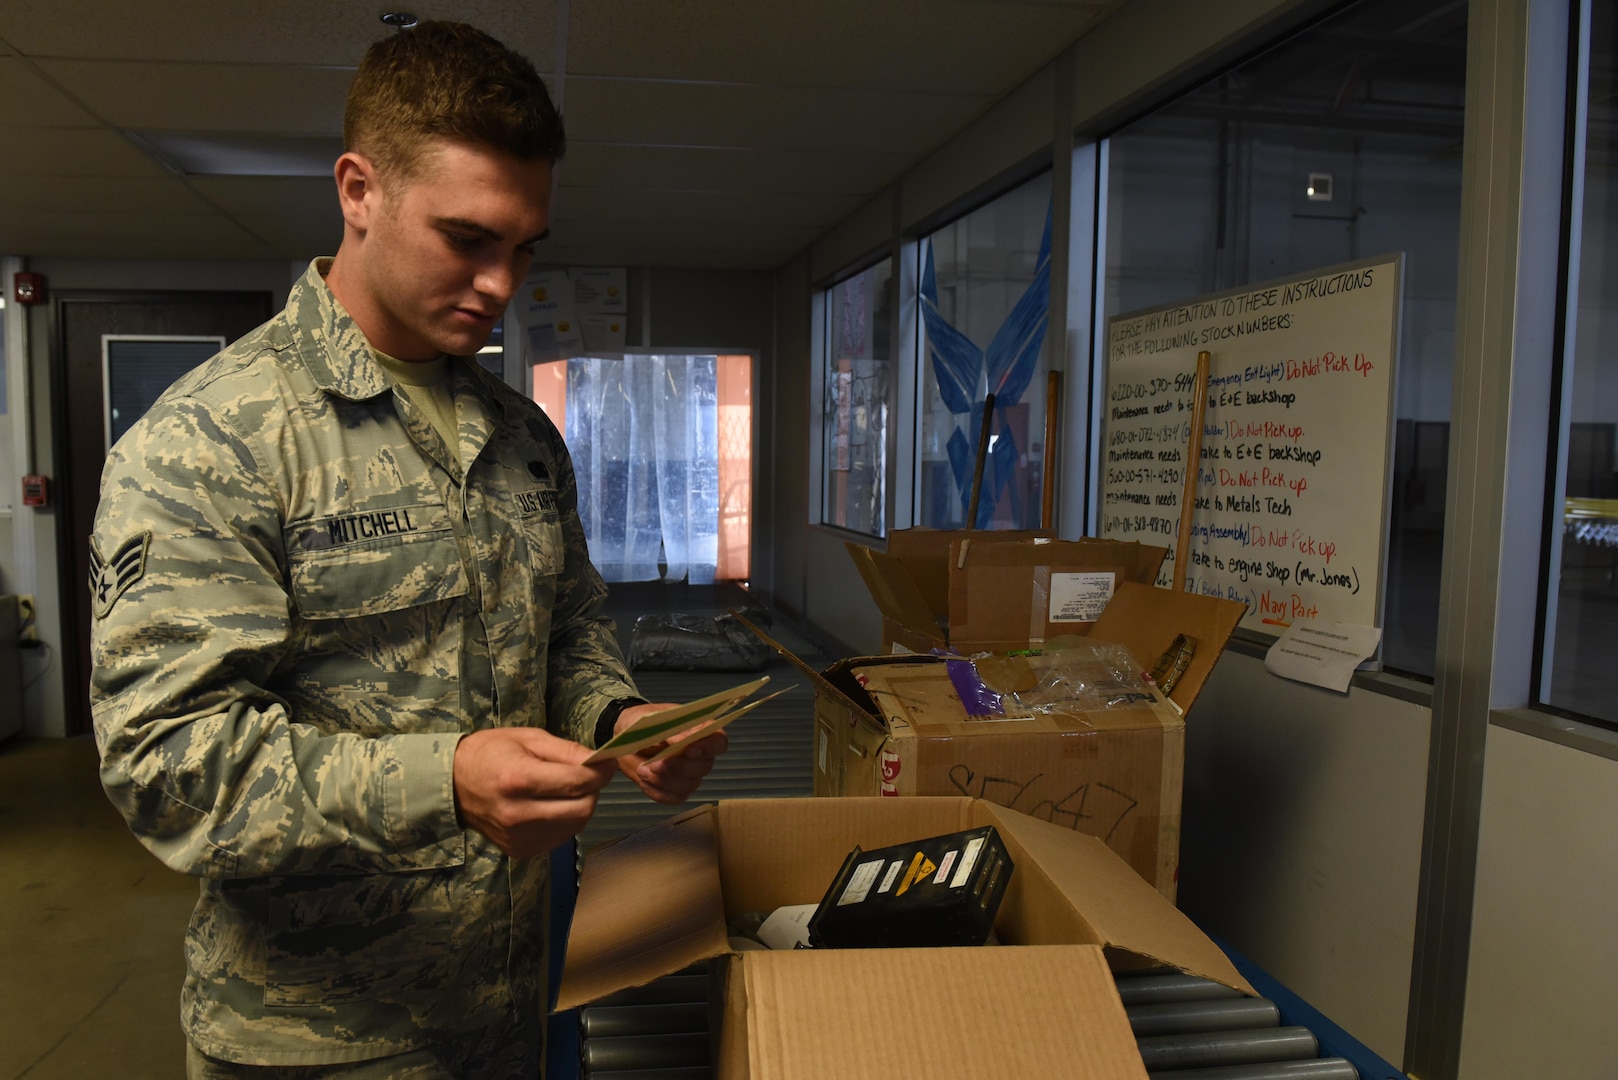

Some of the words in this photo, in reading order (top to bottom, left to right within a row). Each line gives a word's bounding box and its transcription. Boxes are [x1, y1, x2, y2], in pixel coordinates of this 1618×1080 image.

[1144, 312, 1162, 333] PAY
[1162, 303, 1218, 328] ATTENTION
[1221, 298, 1235, 316] TO
[1236, 289, 1278, 315] THESE
[1281, 269, 1374, 306] INSTRUCTIONS
[1112, 342, 1126, 363] FOR
[1127, 340, 1143, 358] THE
[1144, 329, 1198, 356] FOLLOWING
[1286, 359, 1301, 381] Do
[1302, 357, 1321, 378] Not
[1323, 351, 1350, 373] Pick
[1209, 395, 1216, 408] to
[1230, 419, 1244, 440] Do
[1247, 421, 1263, 438] Not
[1158, 448, 1181, 463] needs
[1223, 444, 1233, 459] to
[1219, 468, 1236, 486] Do
[1239, 470, 1259, 488] Not
[1262, 467, 1286, 488] Pick
[1155, 490, 1177, 506] needs
[1195, 496, 1210, 510] ake
[1214, 495, 1223, 511] to
[1226, 494, 1261, 513] Metals
[1264, 497, 1292, 516] Tech
[328, 510, 418, 544] MITCHELL
[1251, 525, 1265, 547] Do
[1268, 528, 1289, 547] Not
[1292, 528, 1317, 556] Pick
[1191, 549, 1211, 568] take
[1214, 556, 1224, 571] to
[1228, 557, 1263, 583] engine
[1260, 590, 1287, 621] Navy
[1291, 594, 1318, 618] Part
